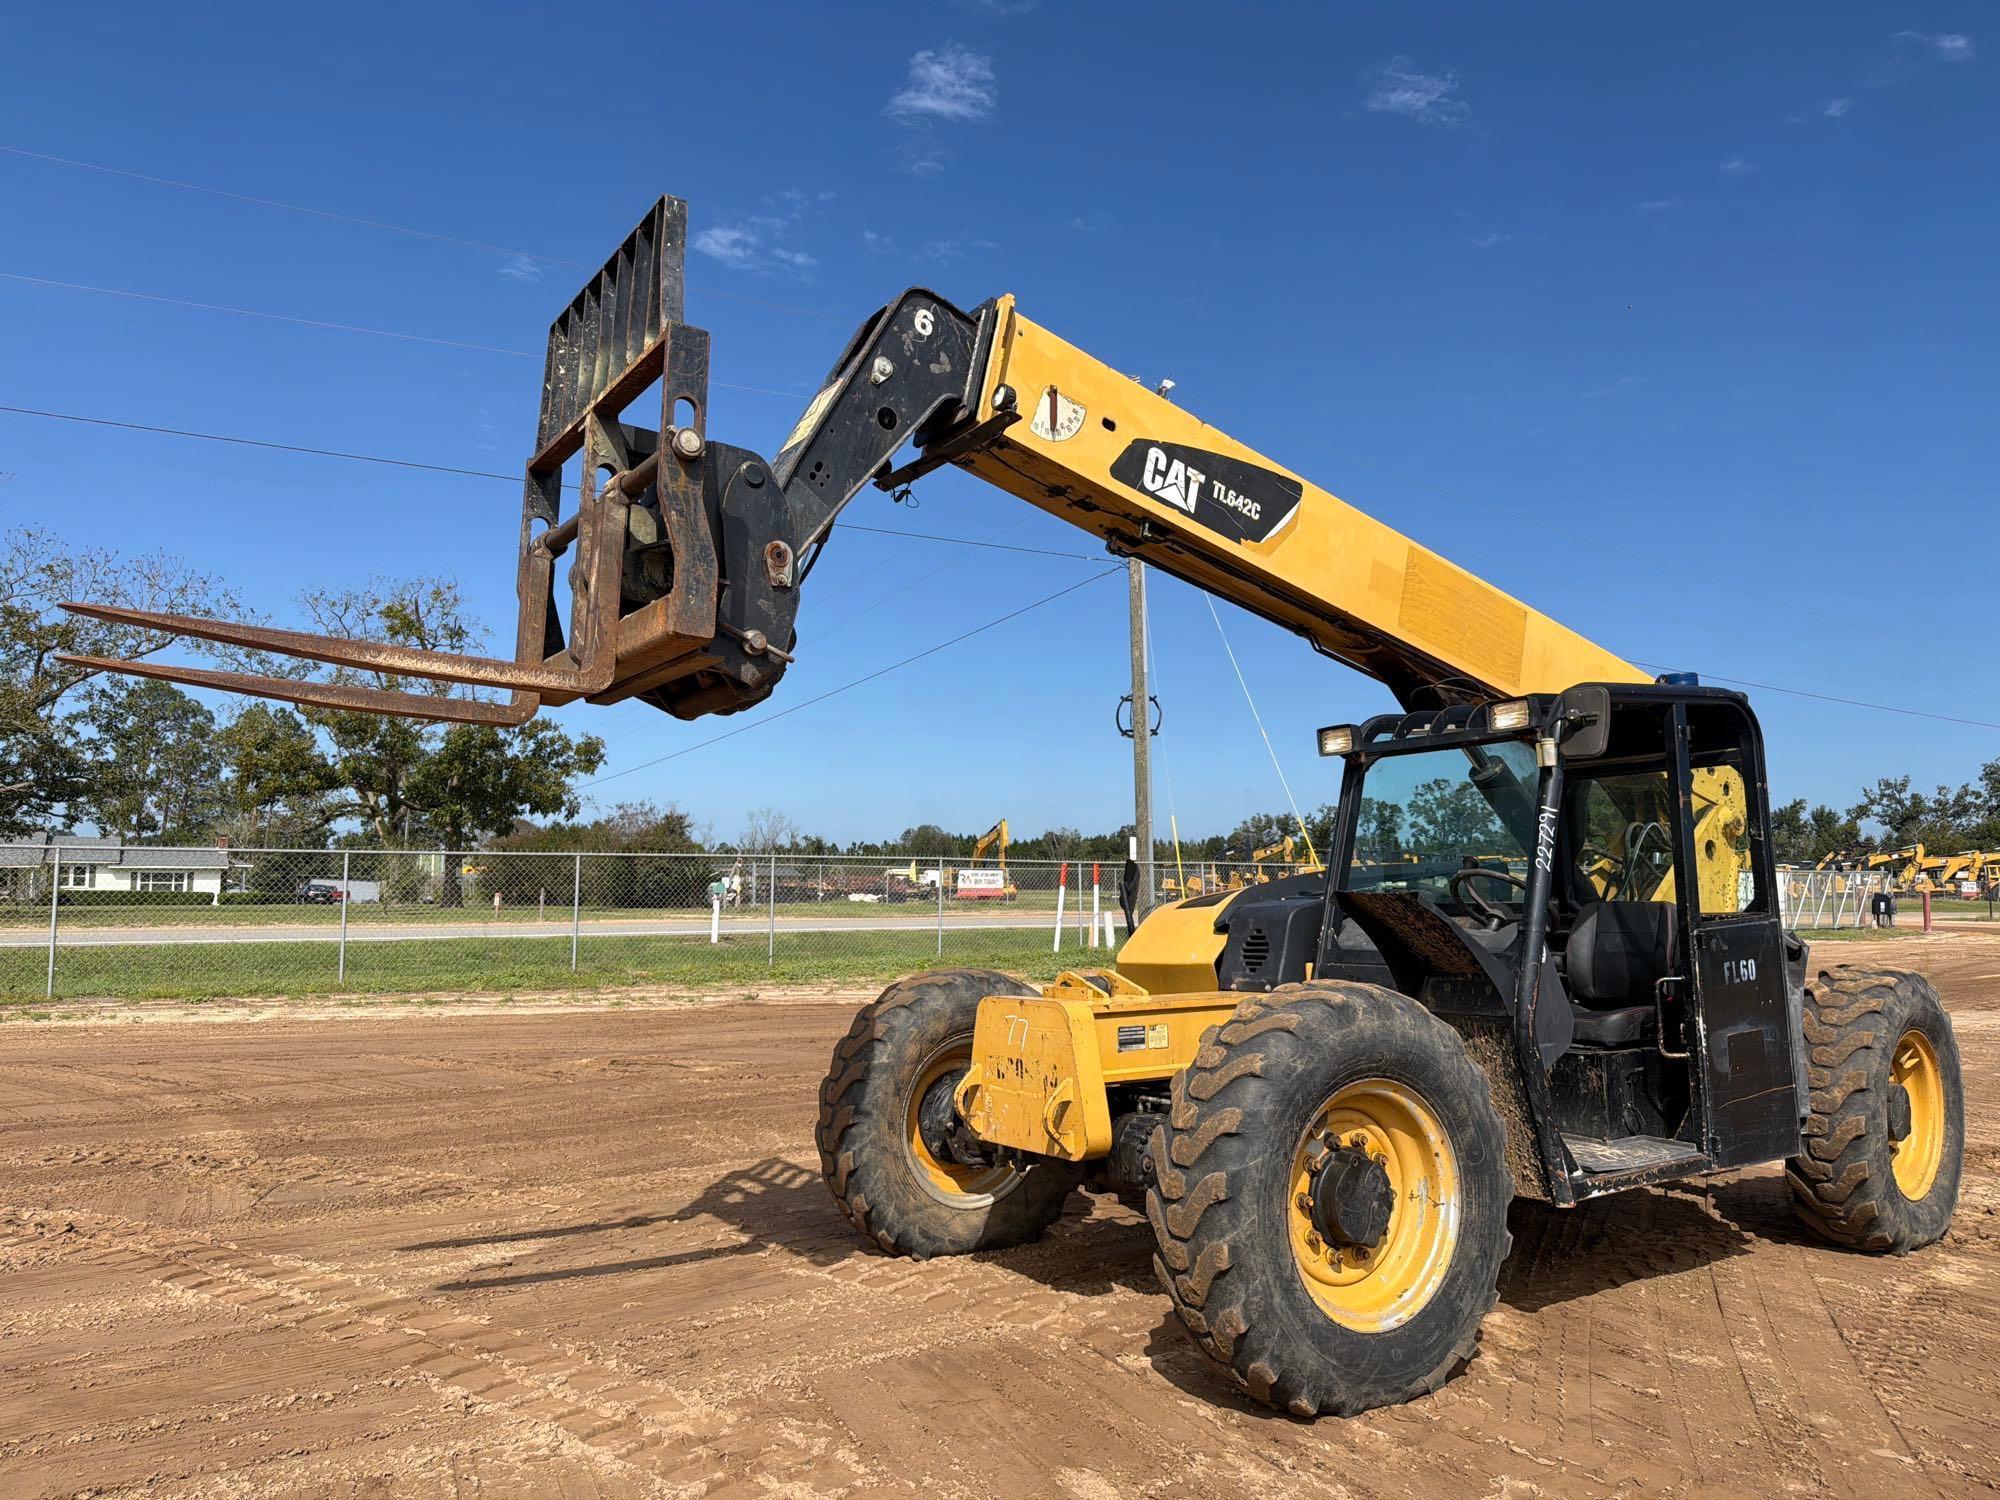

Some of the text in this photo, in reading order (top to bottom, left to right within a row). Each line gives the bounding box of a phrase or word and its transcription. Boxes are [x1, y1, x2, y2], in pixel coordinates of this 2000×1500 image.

[914, 308, 935, 336] 6
[1143, 446, 1262, 521] CAT TL642C
[1535, 805, 1559, 873] 227291
[1723, 958, 1756, 986] FL60
[1005, 1014, 1029, 1052] 77
